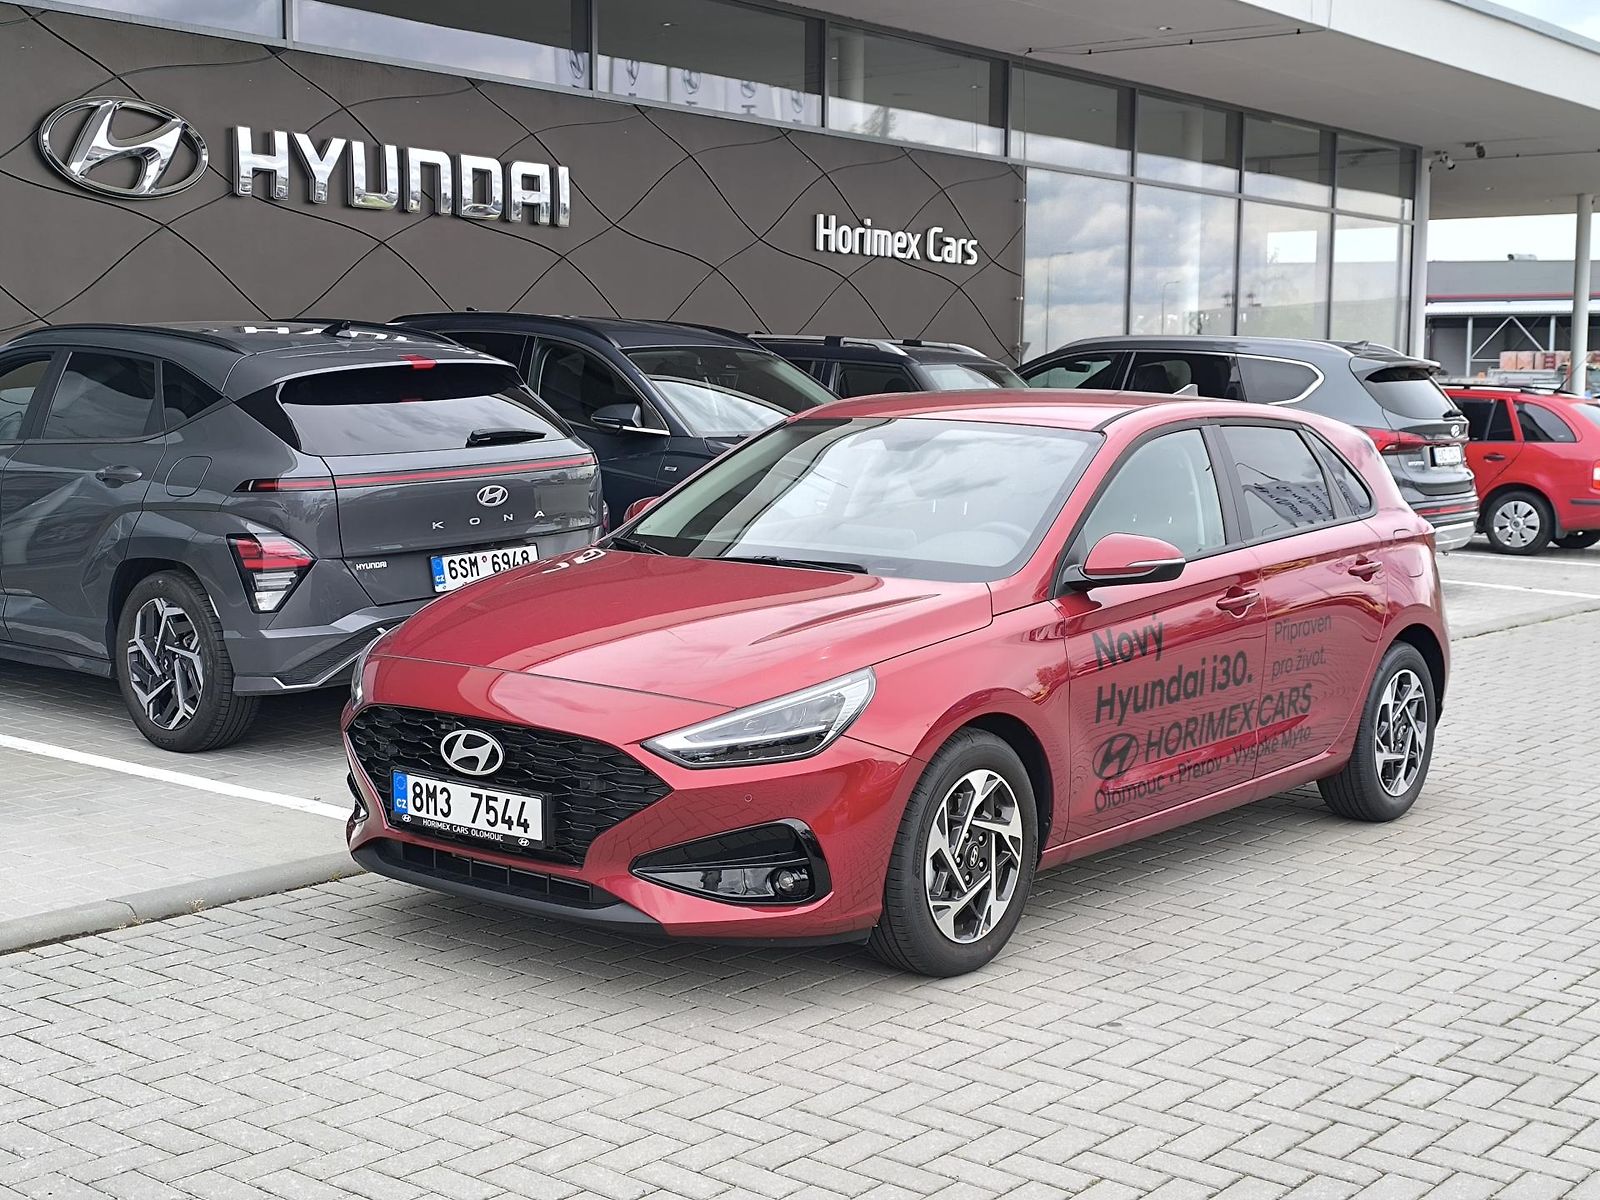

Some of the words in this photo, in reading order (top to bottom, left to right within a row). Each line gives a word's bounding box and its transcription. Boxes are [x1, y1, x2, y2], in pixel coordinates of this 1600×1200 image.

[231, 125, 570, 228] HYUNDAI
[815, 213, 921, 260] Horimex
[927, 226, 978, 265] Cars
[356, 561, 387, 570] HYUNDAI
[448, 556, 480, 580] 6SM
[1092, 615, 1163, 670] Nový
[1095, 657, 1207, 726] Hyundai
[1210, 651, 1253, 693] i30.
[1271, 657, 1293, 683] pro
[1144, 698, 1258, 762] HORIMEX
[1258, 683, 1313, 726] CARS
[396, 798, 407, 808] CZ
[412, 781, 452, 818] 8M3
[470, 792, 530, 834] 7544
[1094, 774, 1166, 812] Olomouc
[1177, 756, 1223, 784] Přerov
[422, 818, 451, 831] HORIMEX
[452, 824, 469, 835] CARS
[471, 828, 504, 842] OLOMOUC
